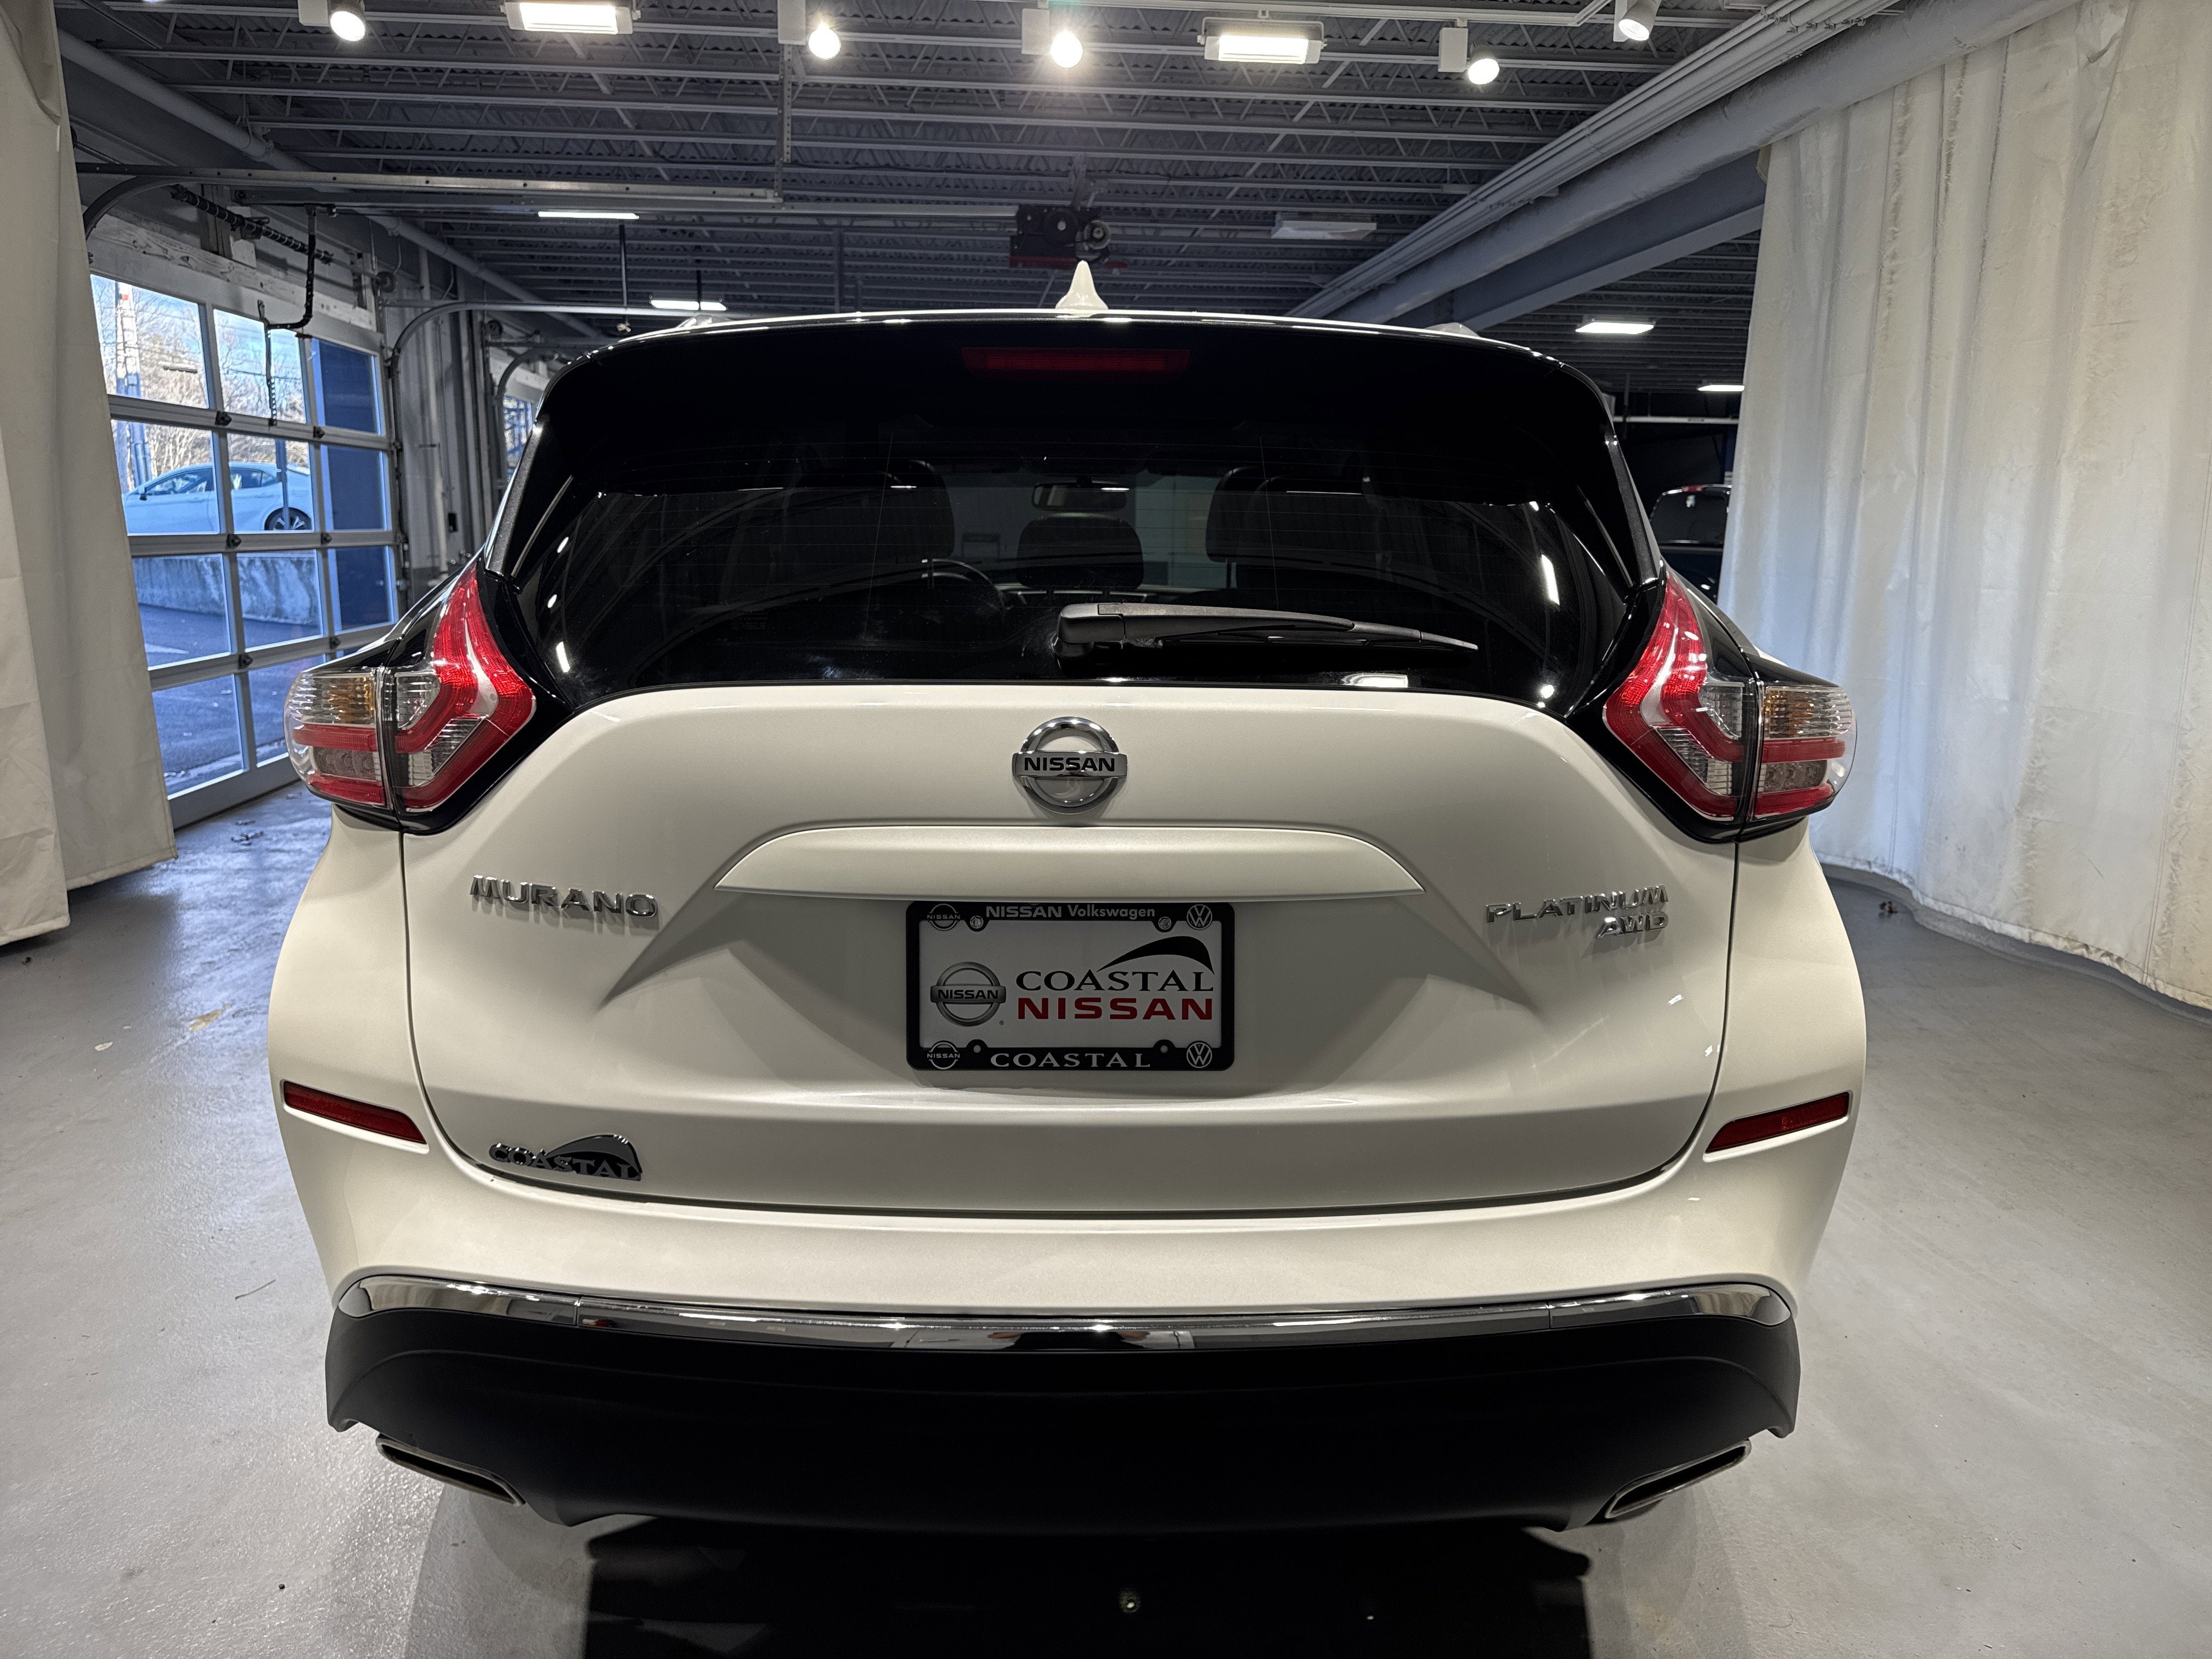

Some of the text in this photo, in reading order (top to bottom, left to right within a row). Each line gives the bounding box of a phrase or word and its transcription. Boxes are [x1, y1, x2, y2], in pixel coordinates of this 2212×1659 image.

[1024, 757, 1115, 772] NISSAN
[470, 875, 658, 917] MURANO
[1486, 884, 1668, 923] PLATINUM
[986, 904, 1155, 920] NISSAN Volkswagen
[1596, 911, 1669, 939] AWD
[1015, 968, 1215, 992] COASTAL
[938, 988, 998, 1000] NISSAN
[1018, 997, 1212, 1020] NISSAN
[990, 1051, 1151, 1068] COASTAL
[489, 1143, 640, 1181] COASTAL
